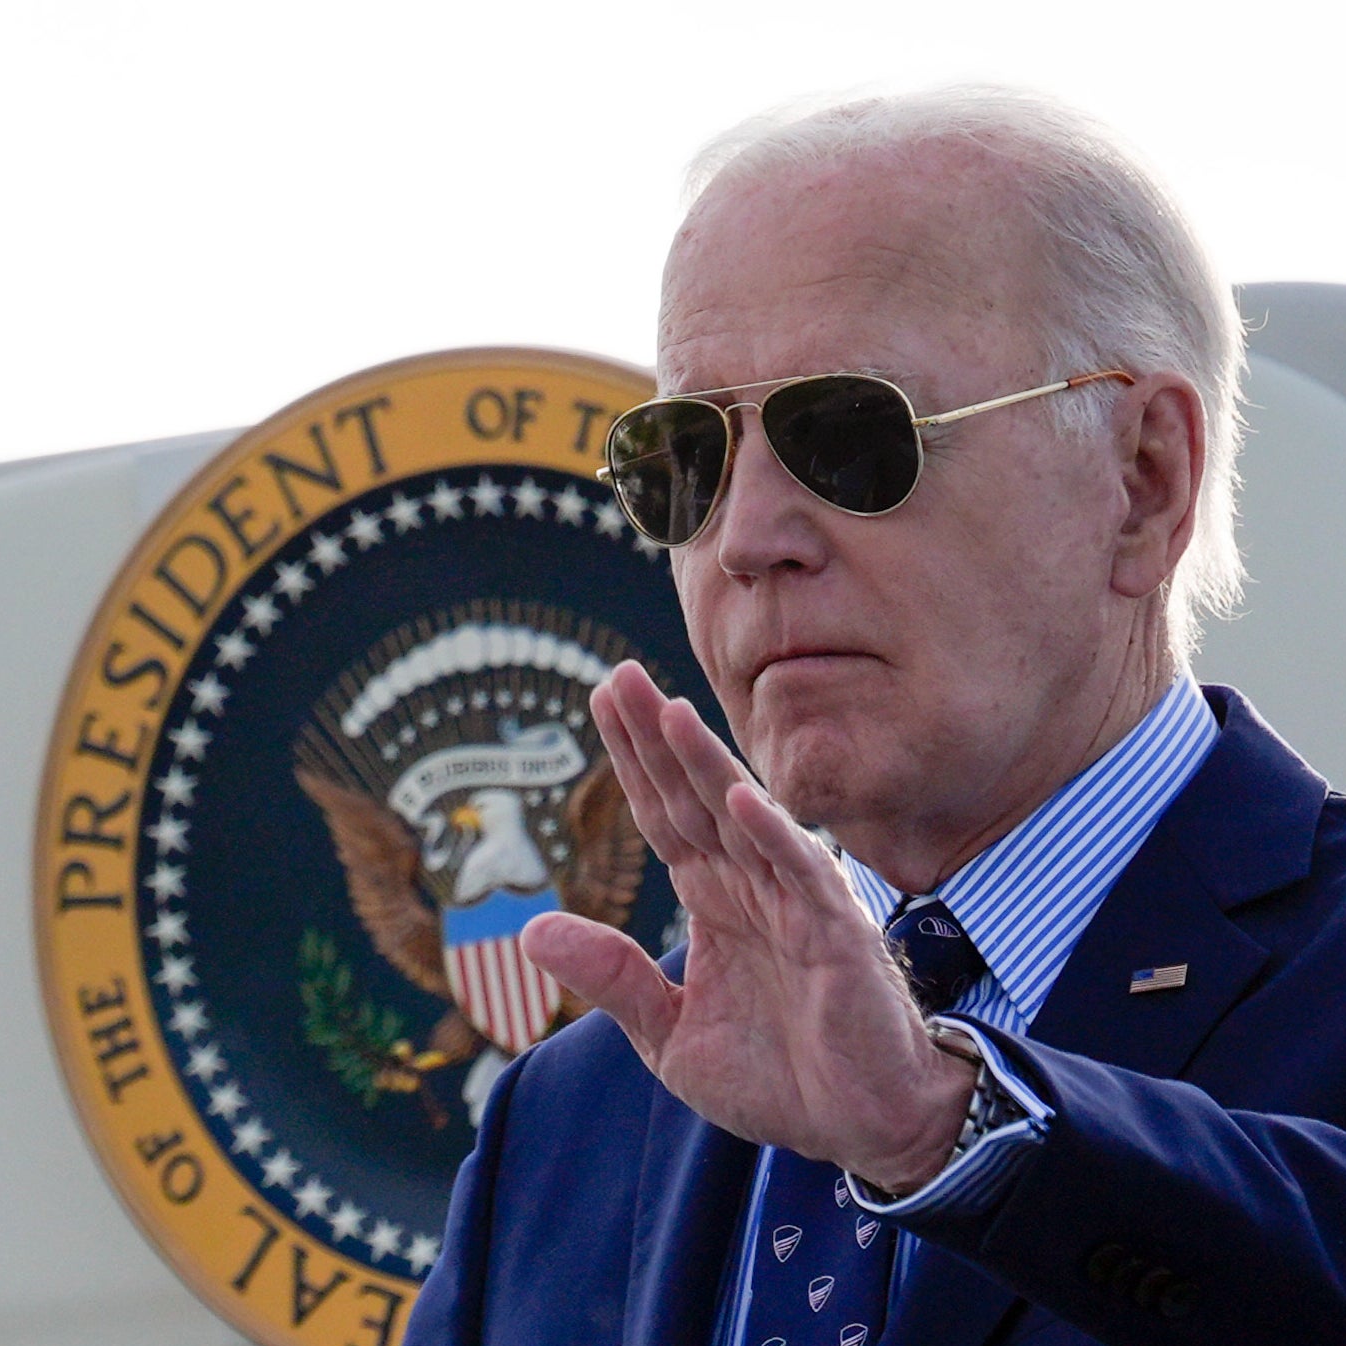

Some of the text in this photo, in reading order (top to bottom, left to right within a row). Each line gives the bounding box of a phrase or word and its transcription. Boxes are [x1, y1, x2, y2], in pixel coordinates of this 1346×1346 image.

[465, 386, 544, 441] OF
[58, 394, 393, 914] PRESIDENT
[79, 978, 151, 1102] THE
[135, 1130, 204, 1204] OF
